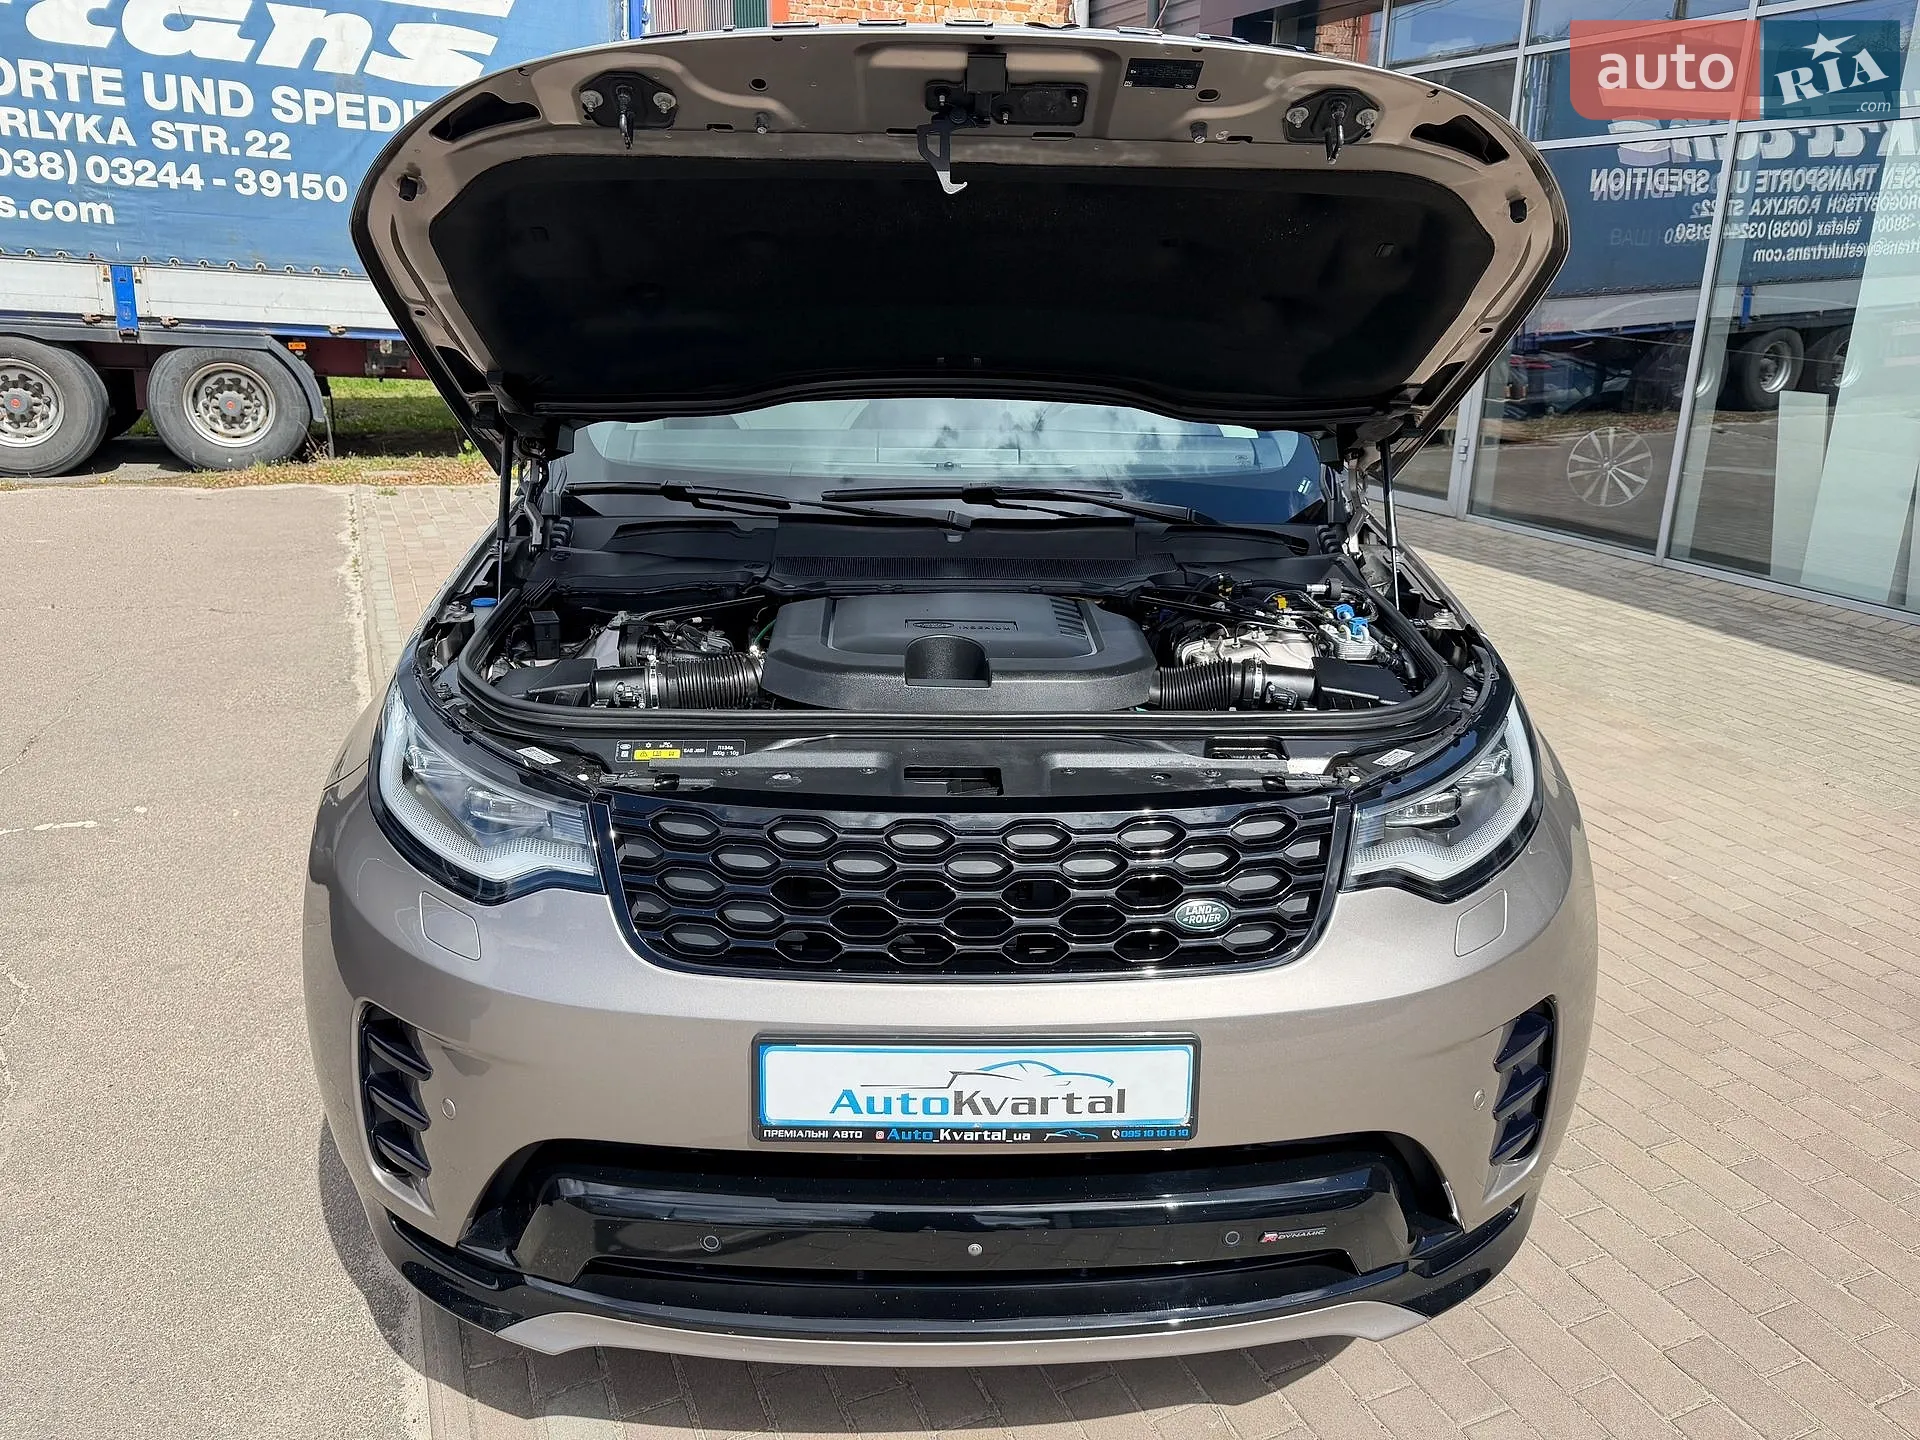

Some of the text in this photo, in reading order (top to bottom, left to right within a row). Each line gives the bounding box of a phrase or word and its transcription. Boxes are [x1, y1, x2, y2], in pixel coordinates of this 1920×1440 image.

[142, 71, 254, 119] UND
[85, 154, 205, 193] 03244
[234, 168, 349, 204] 39150
[1186, 905, 1211, 915] LAND
[1188, 913, 1221, 924] ROVER
[829, 1088, 1126, 1116] AutoKvartal
[832, 1130, 863, 1139] АВТО
